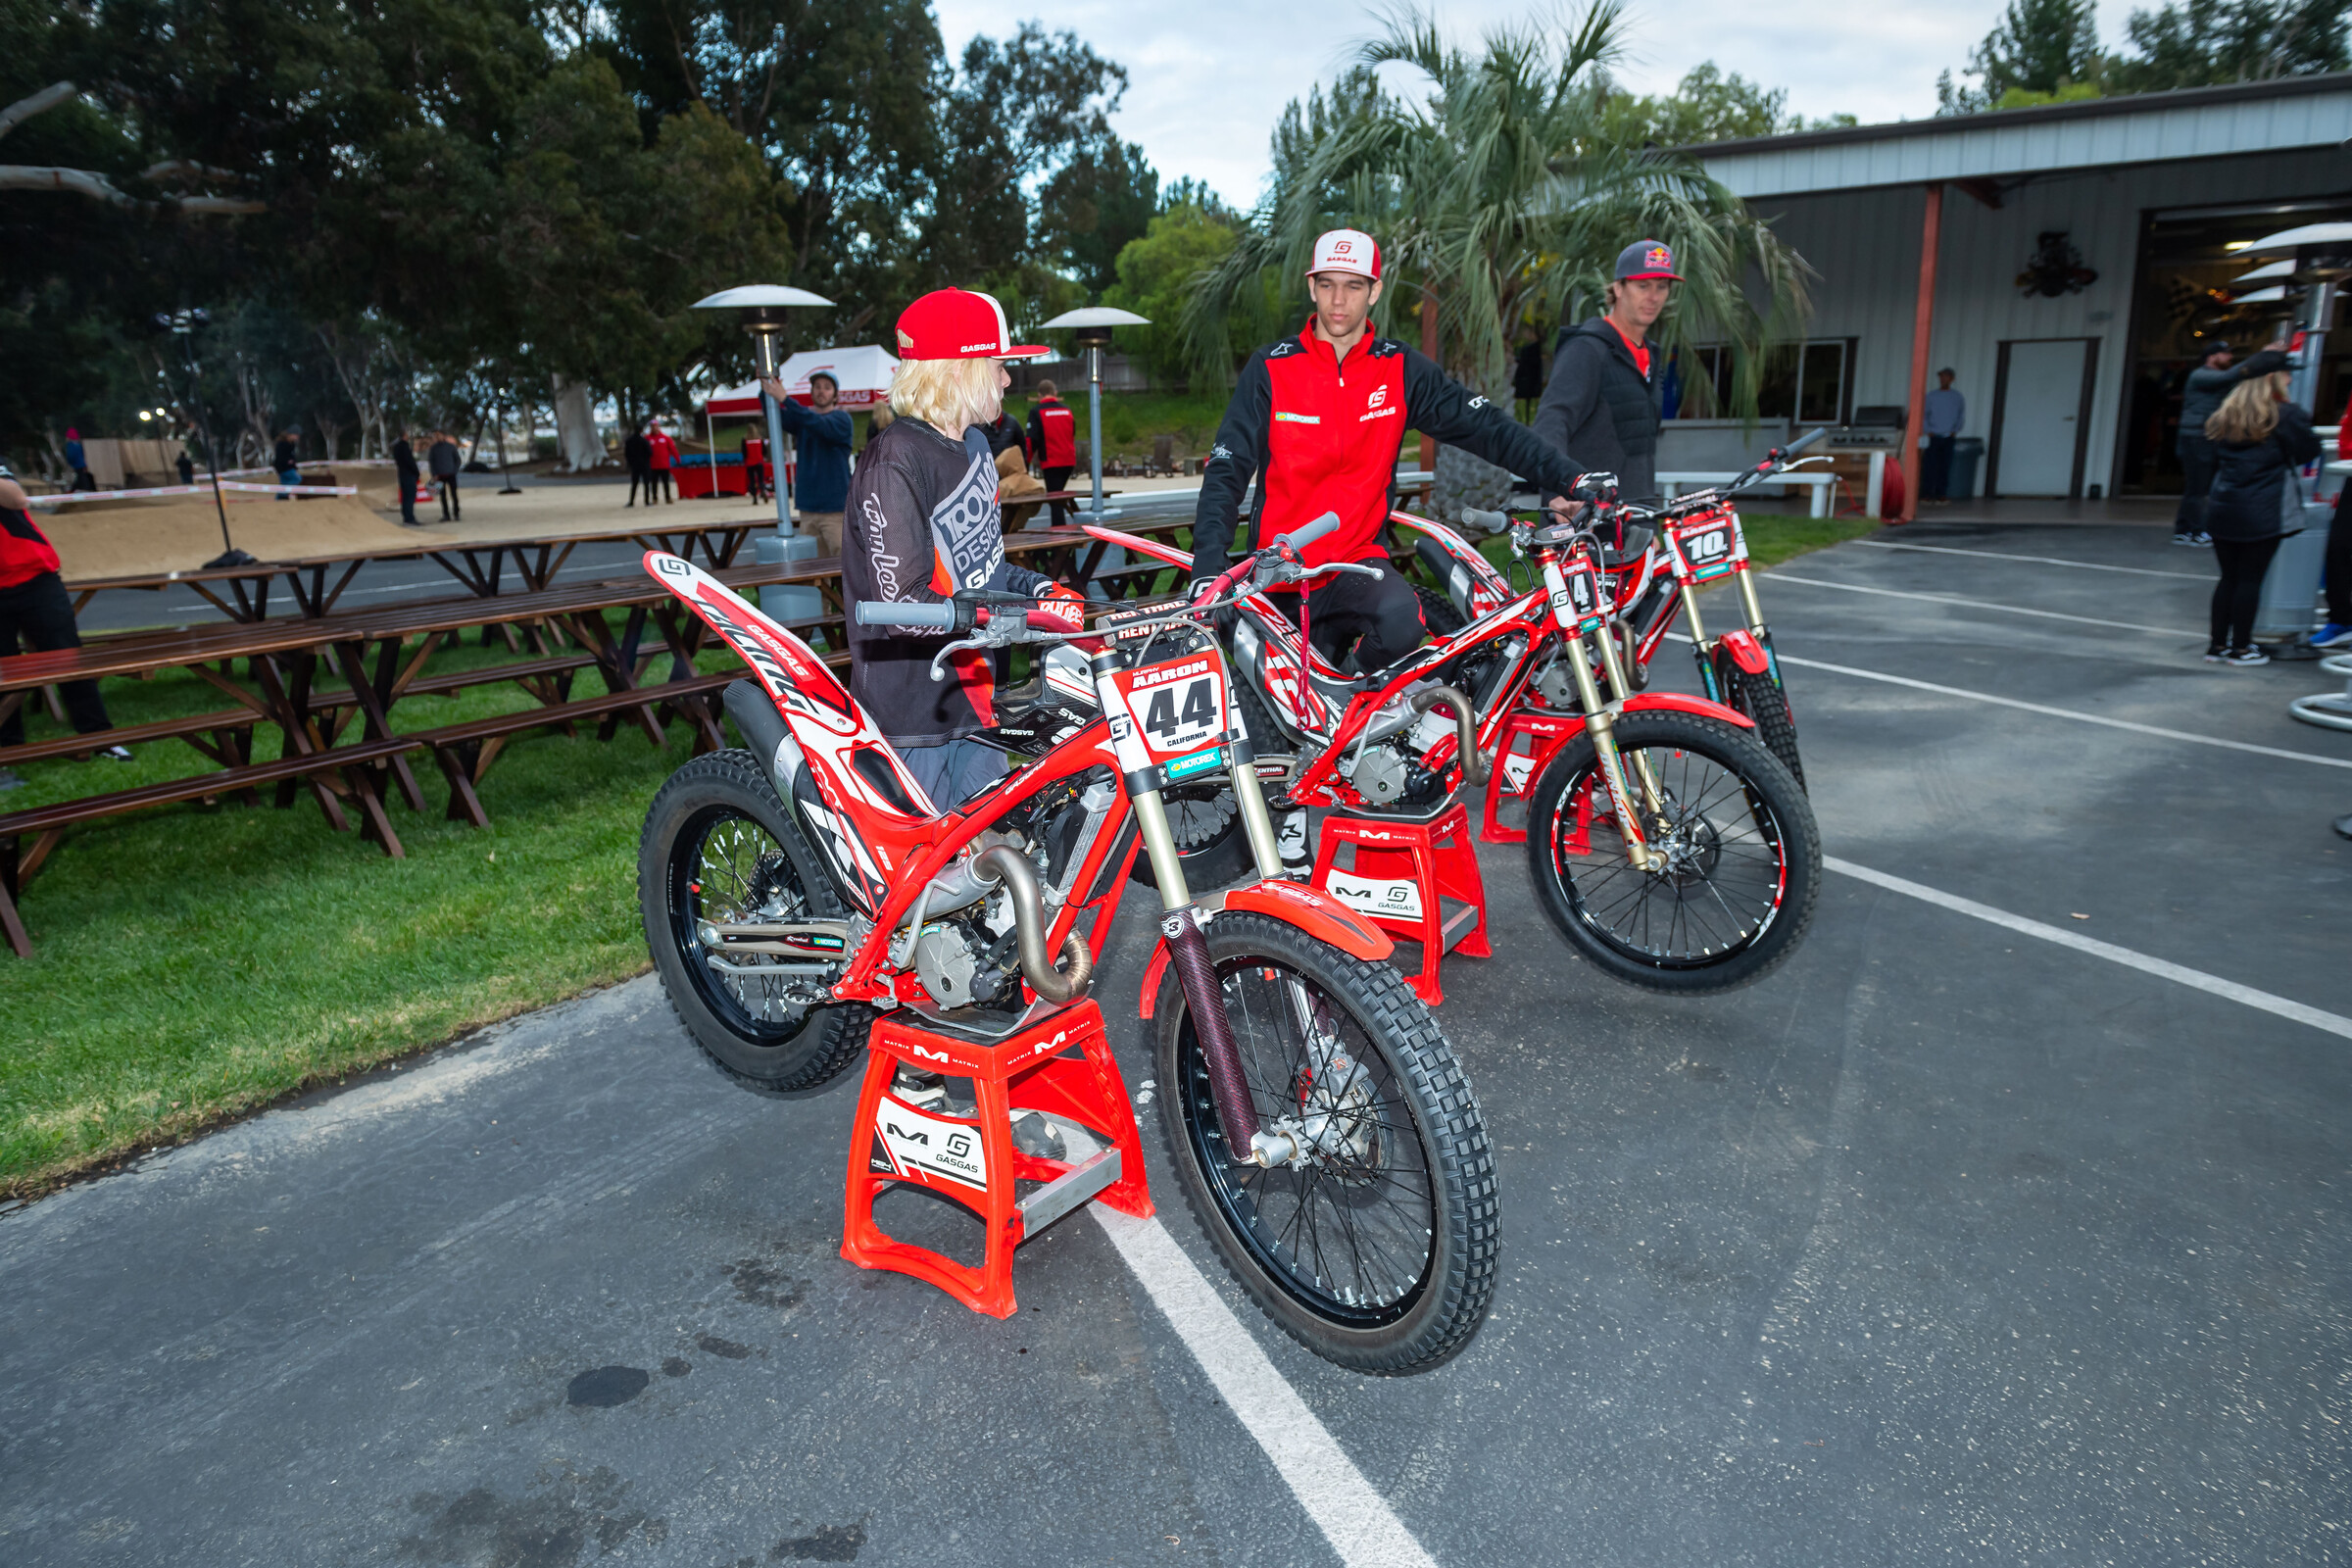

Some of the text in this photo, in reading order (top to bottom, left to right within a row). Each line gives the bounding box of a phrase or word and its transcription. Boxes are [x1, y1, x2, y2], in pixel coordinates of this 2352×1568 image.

[960, 342, 997, 353] GASGAS
[1286, 413, 1320, 424] MOTOREX
[1573, 573, 1590, 606] 4
[1109, 600, 1187, 621] RENTHAL
[747, 623, 809, 678] GASGAS
[1132, 666, 1159, 677] MURPHY
[1132, 660, 1208, 689] AARON
[1146, 677, 1217, 739] 44
[1167, 731, 1207, 747] CALIFORNIA
[1180, 752, 1216, 770] MOTOREX
[1005, 760, 1047, 796] GASGAS
[1599, 751, 1631, 829] DUNLOP
[876, 846, 894, 871] 125
[846, 880, 867, 903] GASGAS
[1378, 902, 1415, 911] GASGAS
[884, 1039, 909, 1051] MATRIX
[952, 1057, 979, 1069] MATRIX
[1006, 1051, 1032, 1065] MATRIX
[1068, 1020, 1091, 1035] MATRIX
[935, 1153, 979, 1174] GASGAS
